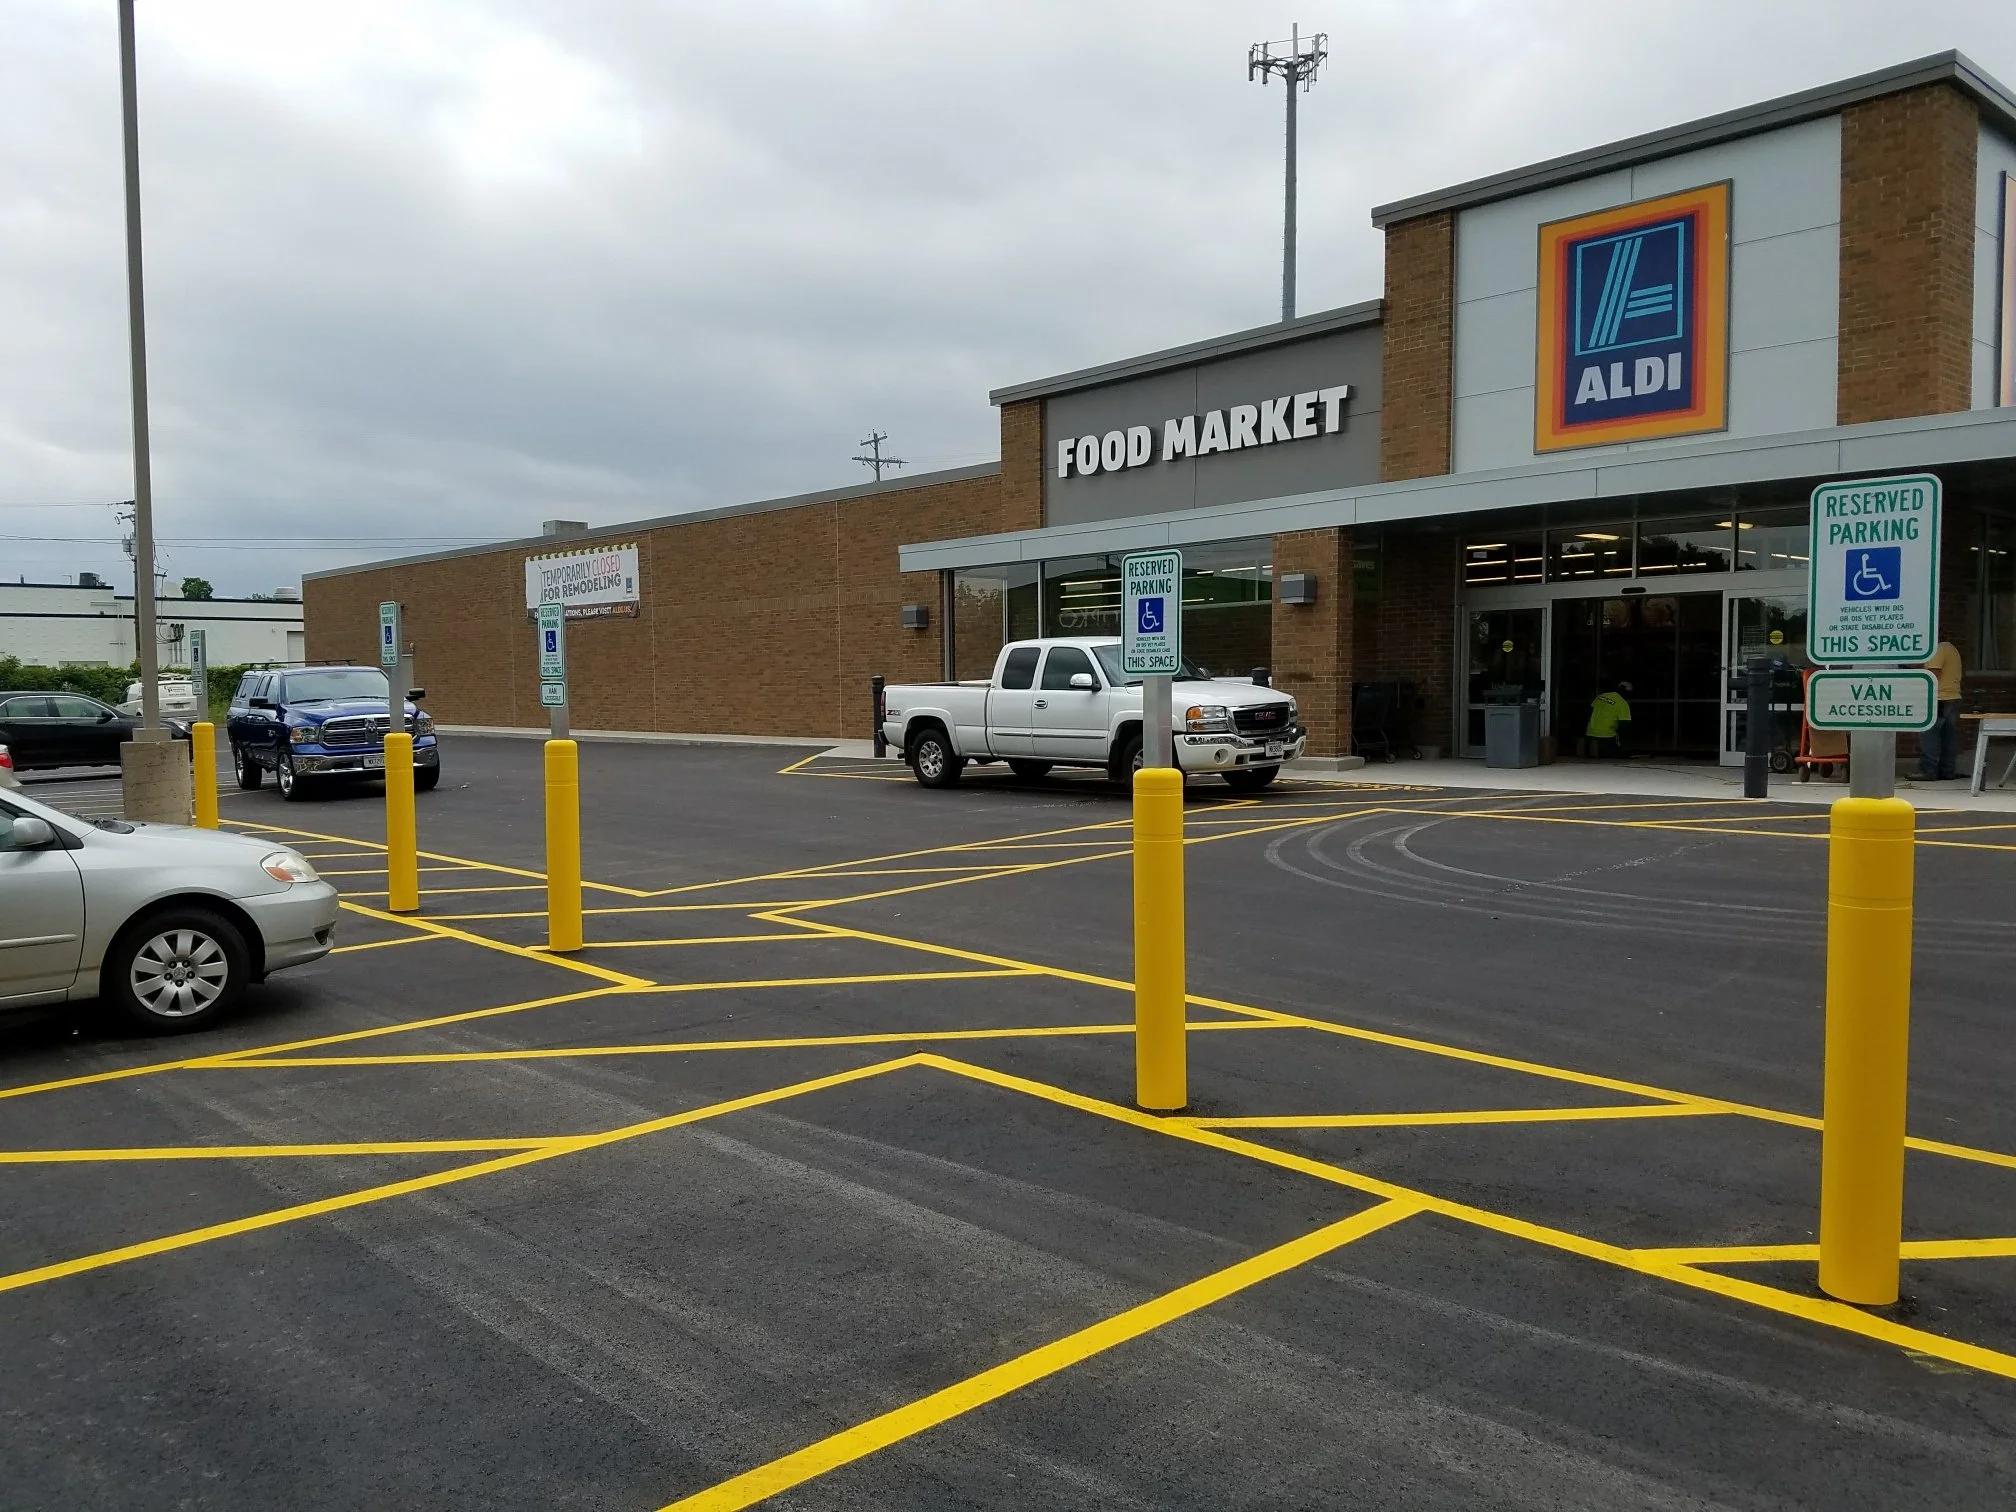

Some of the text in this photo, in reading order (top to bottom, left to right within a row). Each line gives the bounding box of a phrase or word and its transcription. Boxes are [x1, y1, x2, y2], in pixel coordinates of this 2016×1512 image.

[1575, 352, 1681, 405] ALDI
[1058, 384, 1349, 478] FOOD MARKET
[1826, 488, 1923, 517] RESERVED
[1829, 517, 1919, 545] PARKING
[542, 554, 620, 588] TEMPORARILY CLOSED
[1129, 559, 1174, 577] RESERVED
[543, 573, 621, 601] FOR REMODELING
[1130, 578, 1172, 596] PARKING
[540, 607, 559, 618] RESERVED
[583, 607, 599, 615] PLEASE
[599, 606, 612, 614] VISIT
[541, 619, 559, 629] PARKING
[1821, 634, 1923, 653] THIS SPACE
[551, 666, 561, 674] SPACE
[1127, 655, 1175, 668] THIS SPACE
[1850, 684, 1892, 701] VAN
[1829, 704, 1914, 717] ACCESSIBLE
